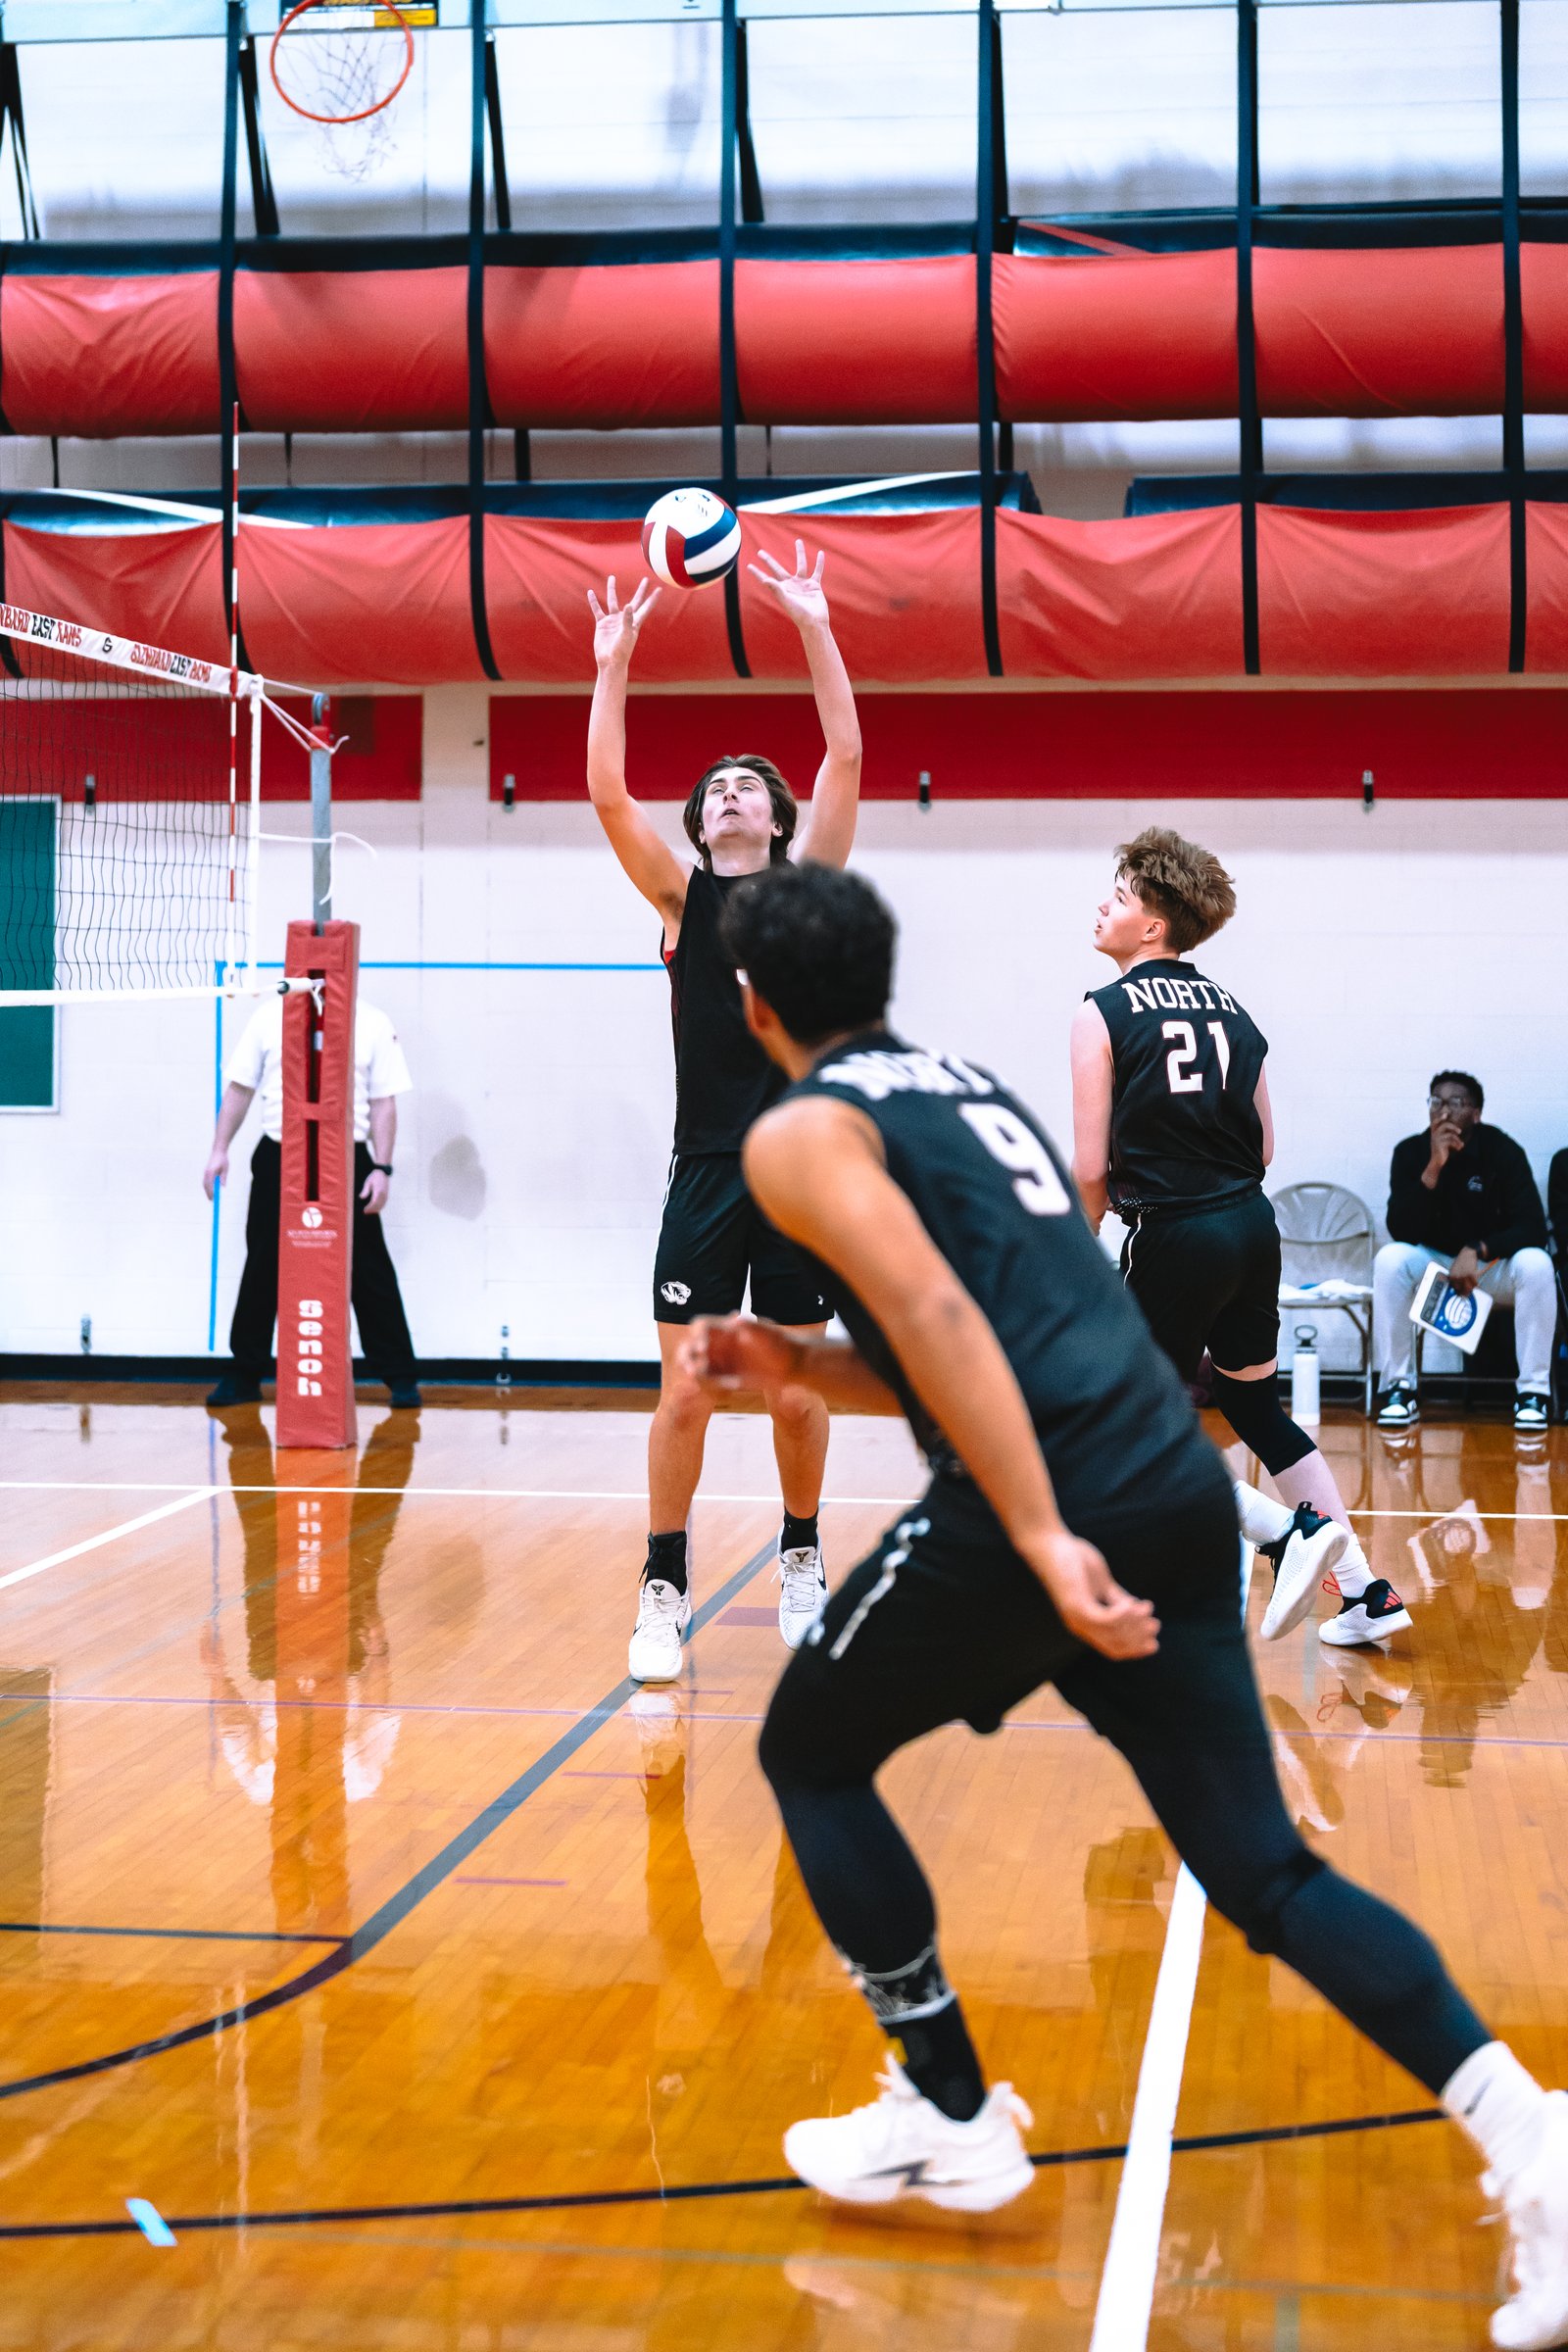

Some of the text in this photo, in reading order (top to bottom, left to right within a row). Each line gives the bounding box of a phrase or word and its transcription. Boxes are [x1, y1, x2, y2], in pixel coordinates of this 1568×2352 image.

[31, 614, 56, 640] EAST
[1121, 977, 1238, 1015] NORTH
[1160, 1019, 1231, 1094] 21
[957, 1102, 1071, 1216] 9
